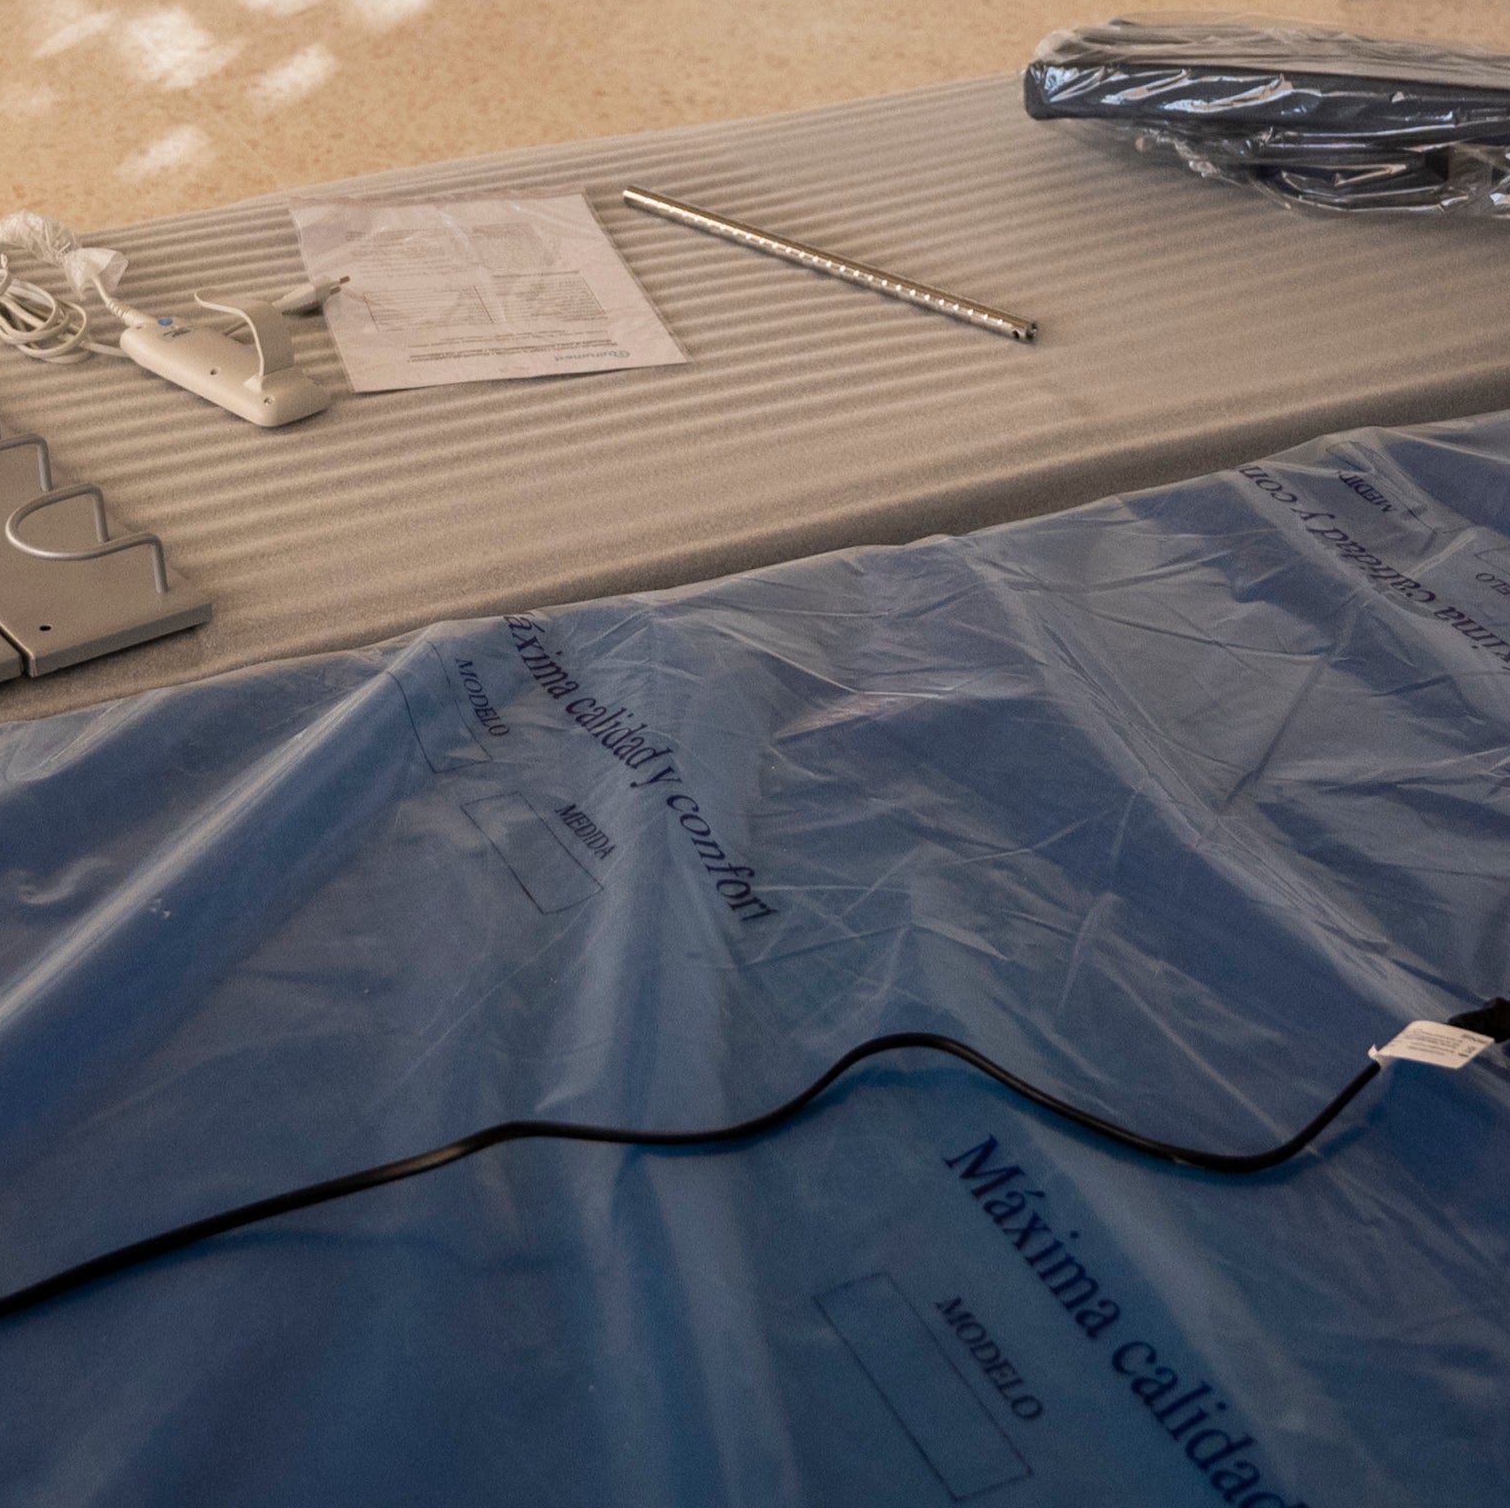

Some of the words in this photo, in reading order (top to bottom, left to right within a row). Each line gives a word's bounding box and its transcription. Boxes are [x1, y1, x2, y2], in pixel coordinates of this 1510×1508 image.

[1291, 507, 1336, 522] y
[1308, 526, 1436, 603] calidad
[455, 658, 510, 737] MODELO
[504, 614, 580, 700] áxima
[564, 697, 674, 770] calidad
[629, 765, 682, 789] y
[555, 804, 616, 860] MEDIDA
[942, 1133, 1122, 1341] Máxima
[935, 1296, 1044, 1422] MODELO
